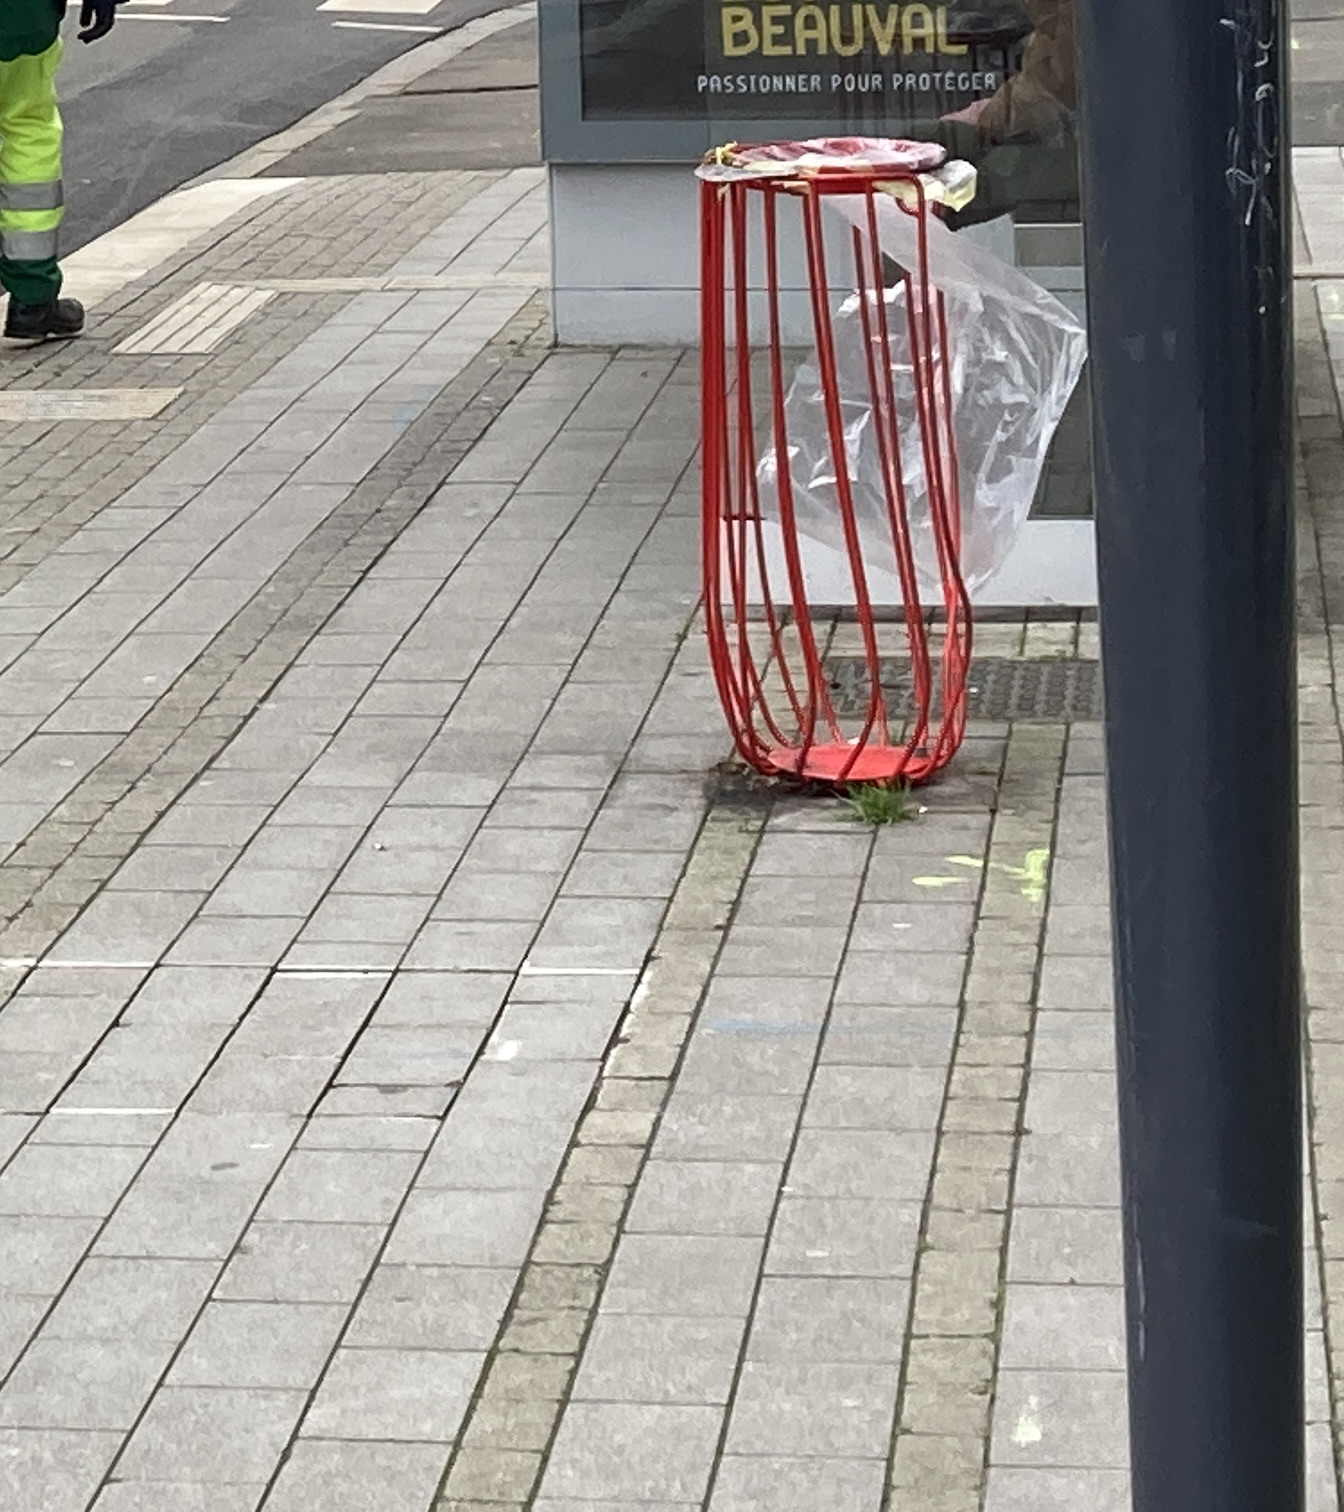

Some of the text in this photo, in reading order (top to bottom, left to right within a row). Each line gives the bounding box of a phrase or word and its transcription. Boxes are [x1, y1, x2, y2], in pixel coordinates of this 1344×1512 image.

[720, 2, 969, 57] BEAUVAL
[696, 73, 822, 94] PASSIONNER
[830, 72, 883, 93] POUR
